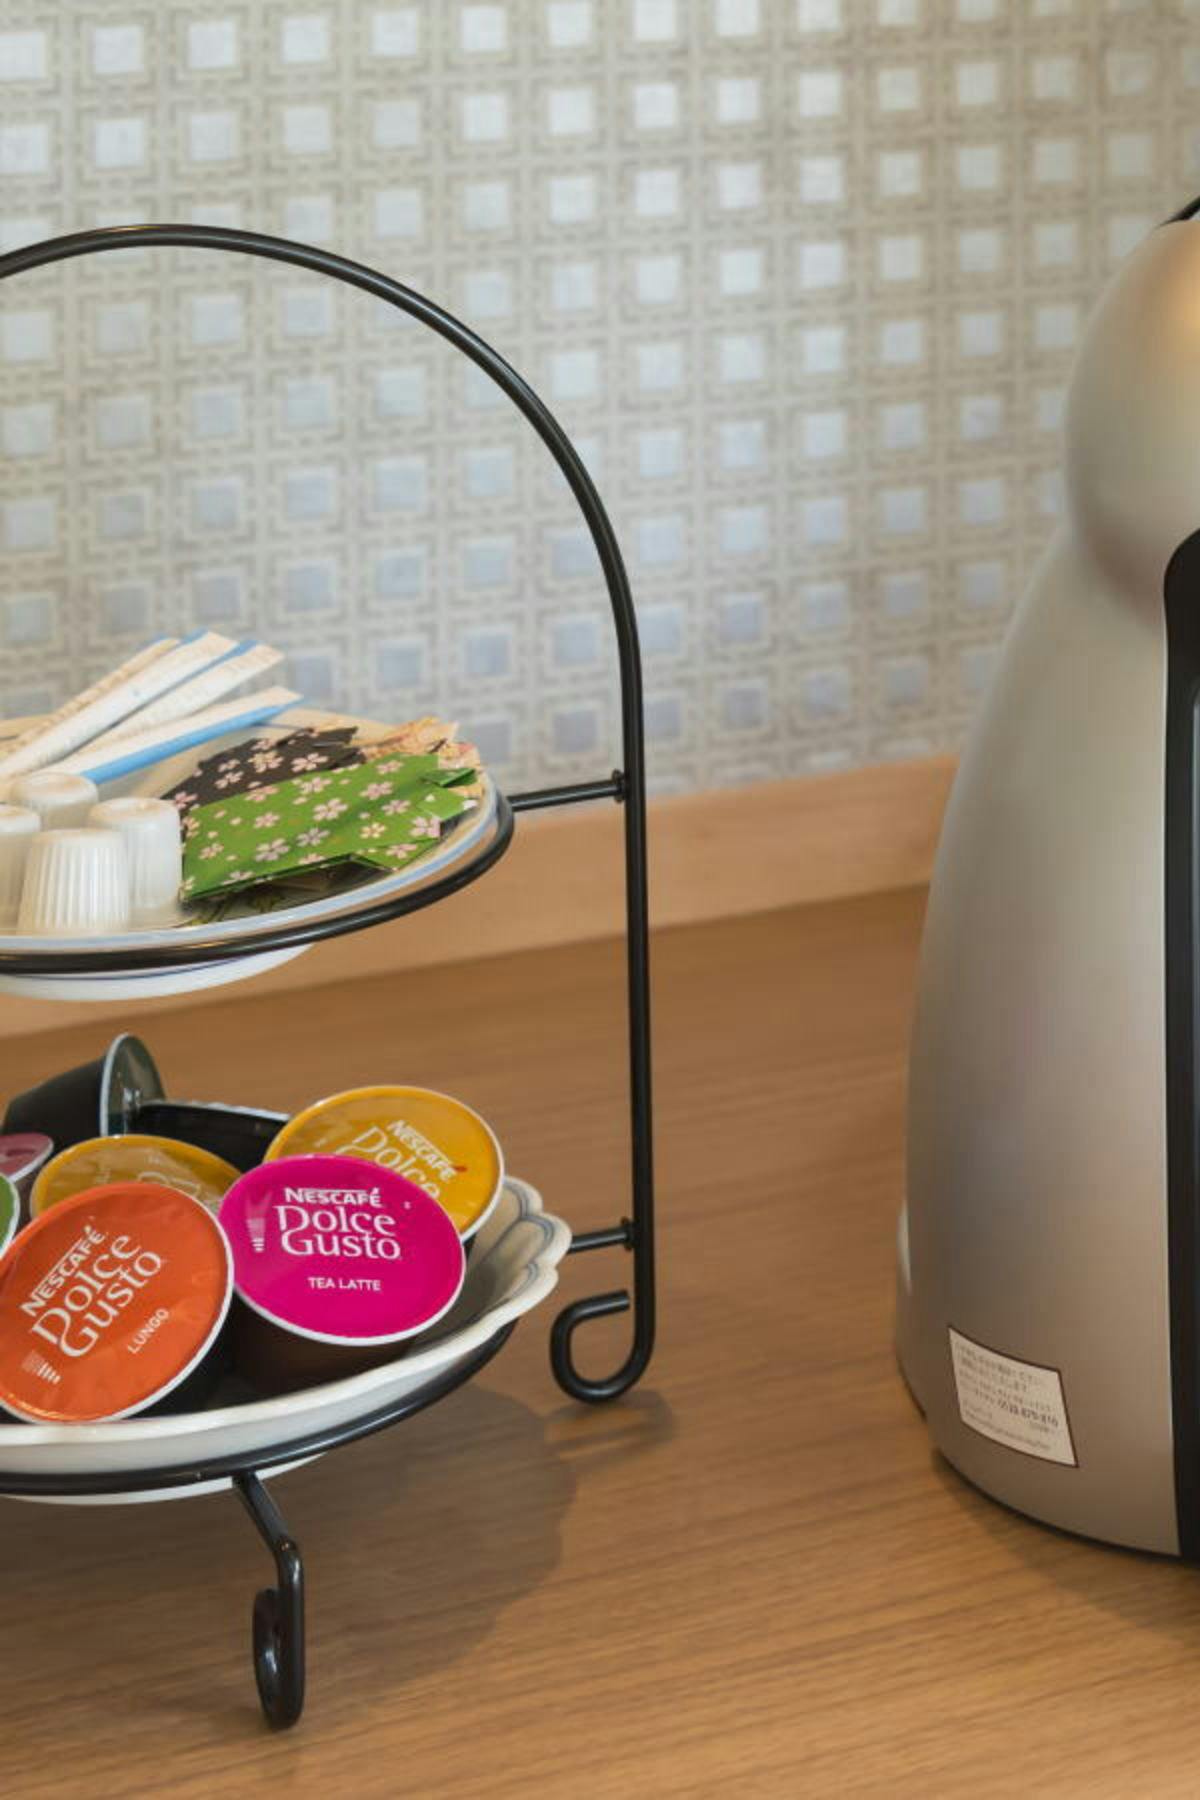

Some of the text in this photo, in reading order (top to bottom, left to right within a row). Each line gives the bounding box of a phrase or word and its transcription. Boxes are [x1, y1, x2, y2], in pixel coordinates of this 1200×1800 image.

[284, 1186, 384, 1208] NESCAFÉ
[274, 1205, 396, 1237] Dolce
[281, 1231, 401, 1260] Gusto
[20, 1224, 105, 1317] NESCAFÉ
[31, 1235, 142, 1345] Dolce
[308, 1277, 382, 1292] TEA LATTE
[60, 1251, 162, 1357] Gusto
[127, 1308, 170, 1354] LUNGO
